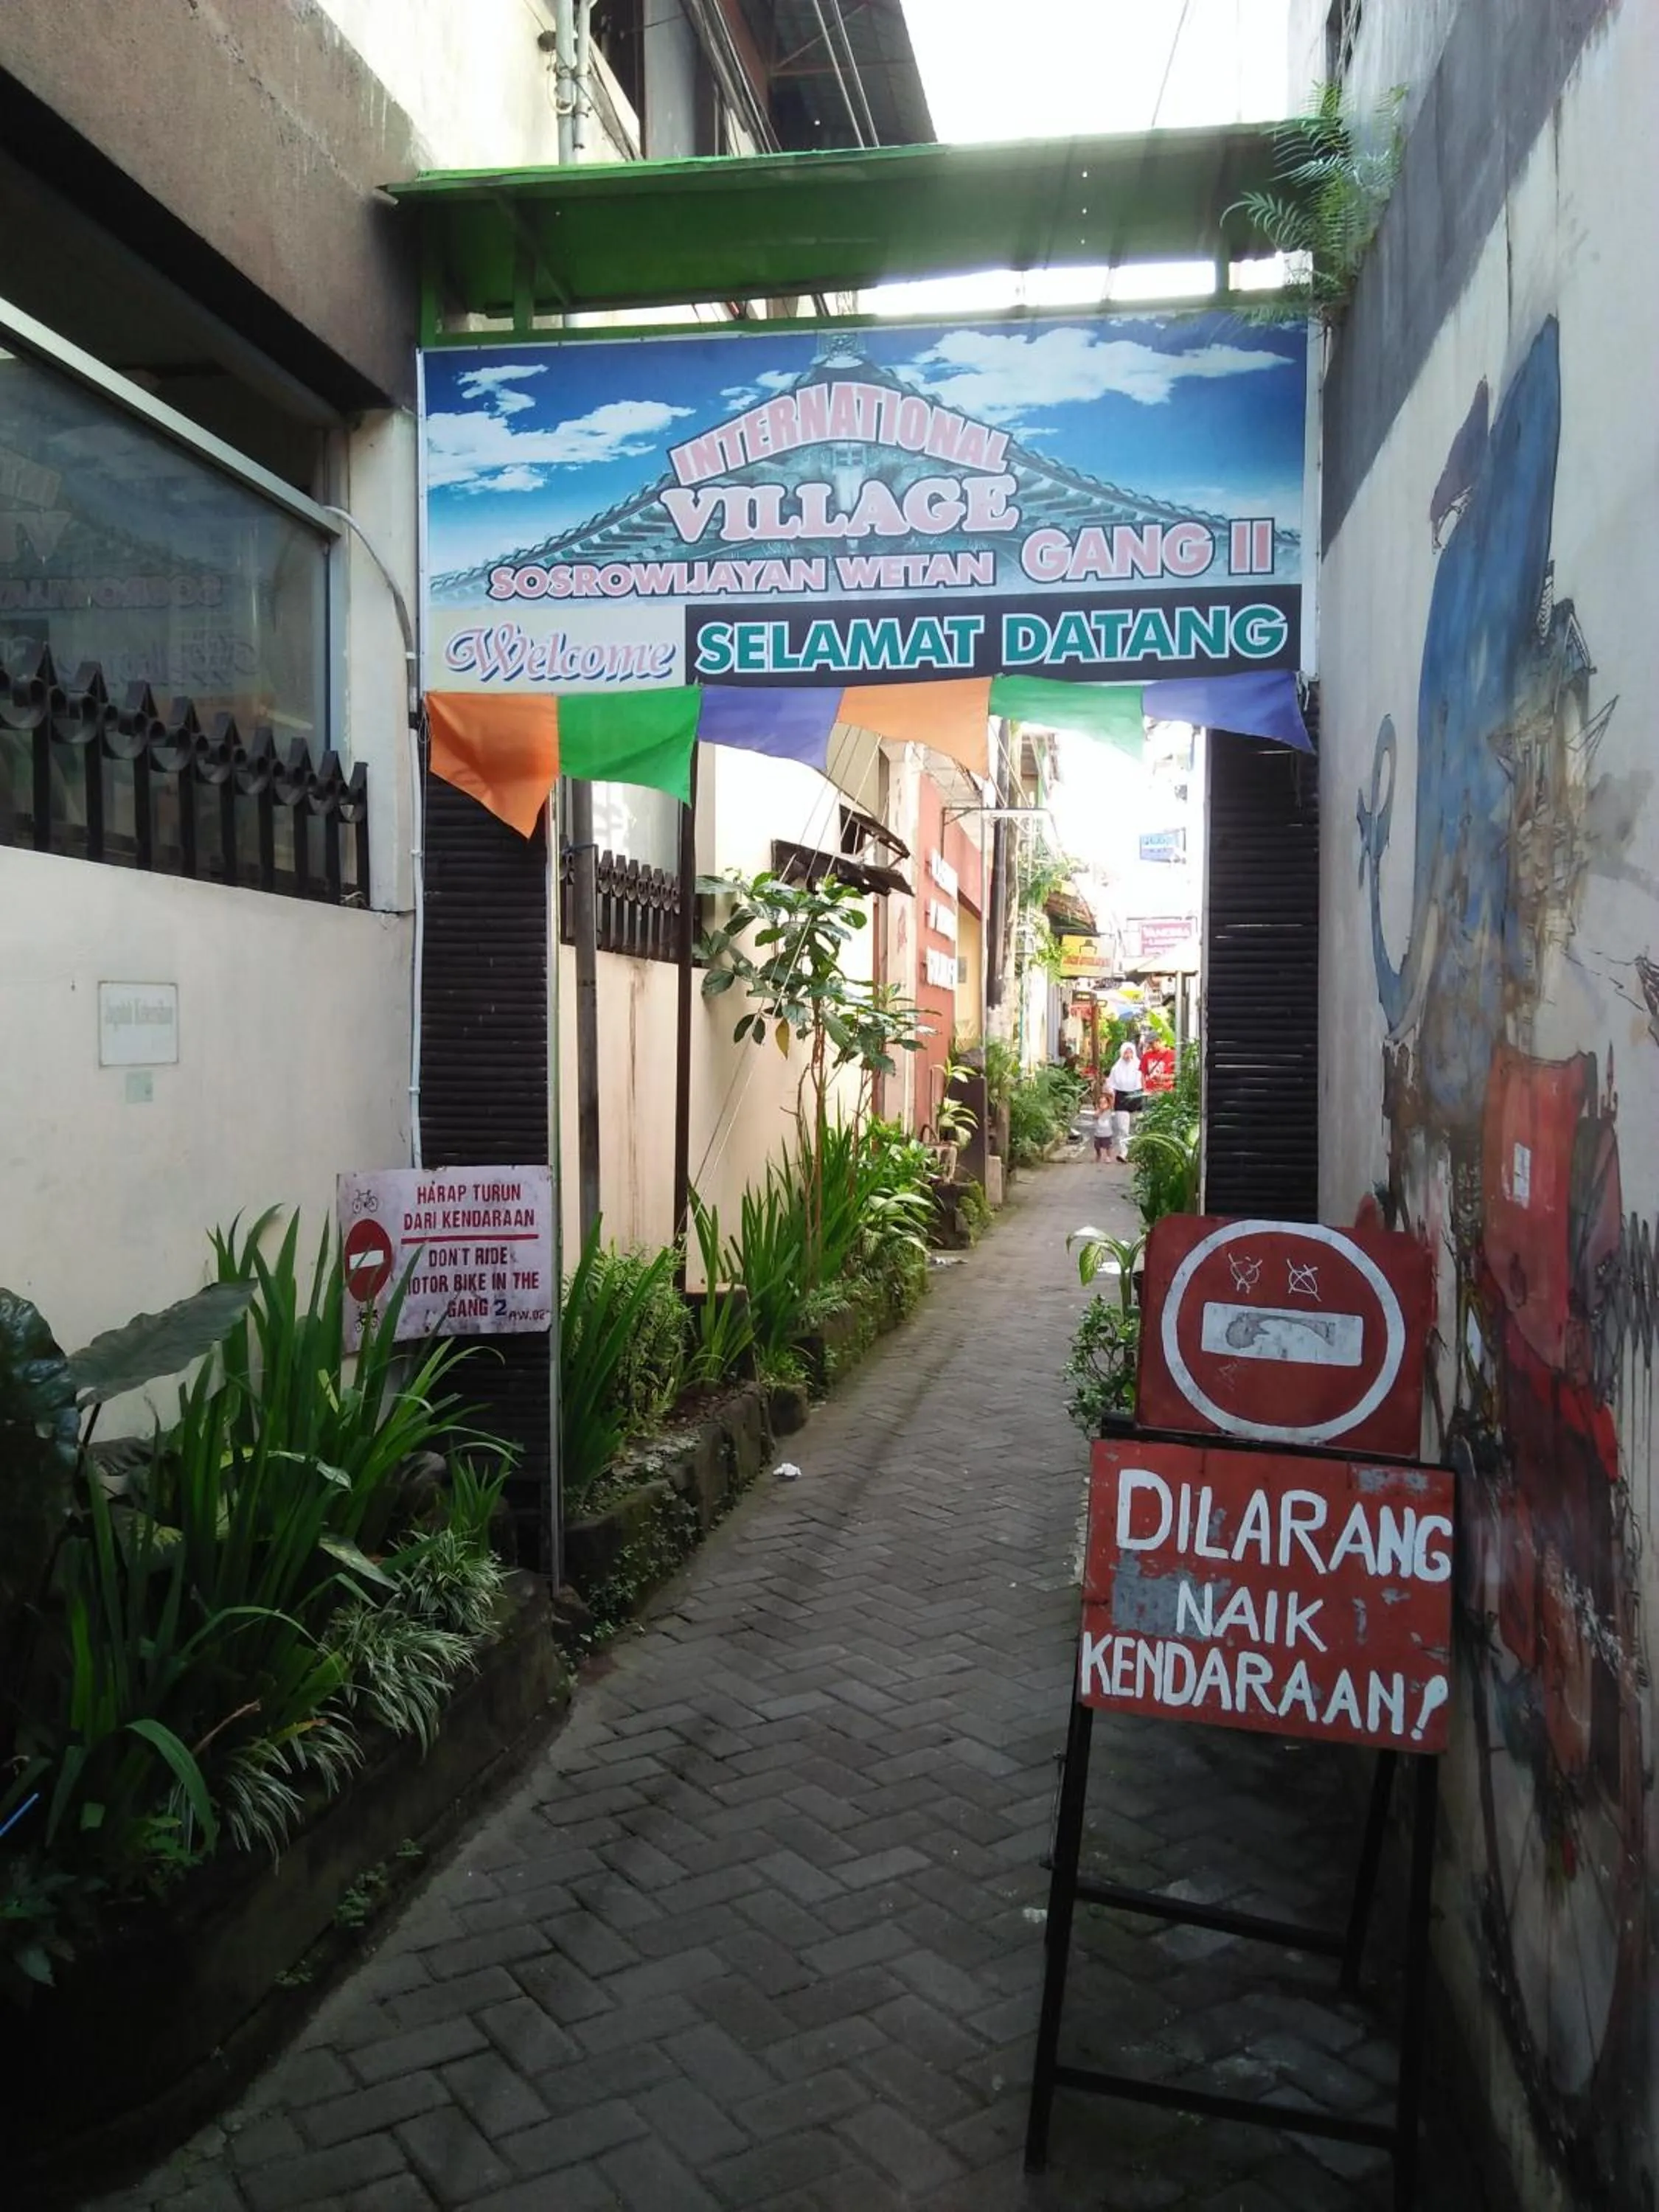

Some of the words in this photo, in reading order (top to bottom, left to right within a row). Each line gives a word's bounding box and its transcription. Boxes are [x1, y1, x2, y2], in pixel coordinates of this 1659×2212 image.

[668, 380, 1012, 487] INTERNATIONAL
[661, 473, 1020, 543] VILLAGE
[487, 557, 829, 601] SOSROWIJAYAN
[835, 551, 995, 592] WETAN
[1020, 521, 1215, 584] GANG
[1229, 518, 1276, 575] II
[445, 623, 678, 684] Welcome
[695, 615, 985, 674] SELAMAT
[1002, 604, 1288, 666] DATANG
[403, 1213, 437, 1231] DARI
[442, 1209, 535, 1229] KENDARAAN
[417, 1183, 467, 1204] HARAP
[473, 1183, 521, 1202] TURUN
[428, 1248, 470, 1267] DON'T
[475, 1246, 508, 1265] RIDE
[453, 1273, 486, 1292] BIKE
[492, 1273, 507, 1290] IN
[512, 1272, 540, 1290] THE
[447, 1298, 488, 1318] GANG
[493, 1299, 508, 1316] 2
[1116, 1469, 1453, 1582] DILARANG
[1176, 1580, 1327, 1652] NAIK
